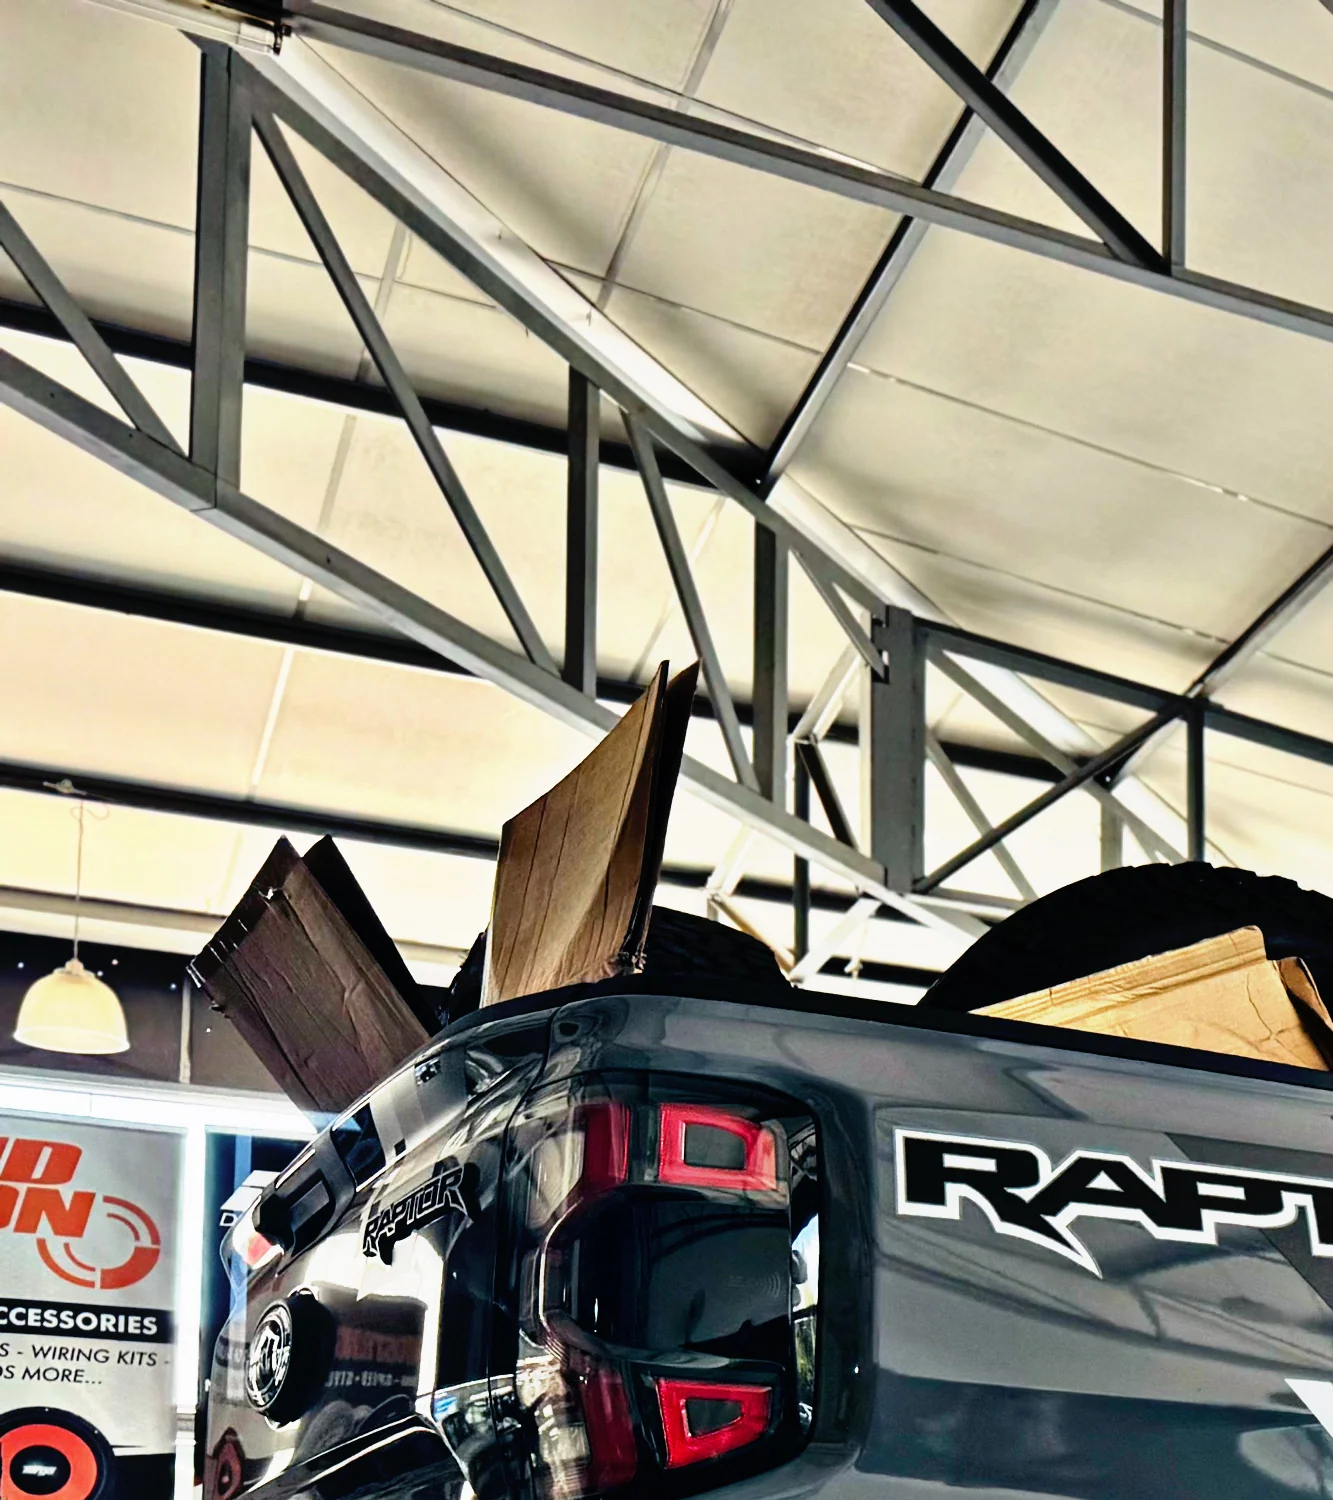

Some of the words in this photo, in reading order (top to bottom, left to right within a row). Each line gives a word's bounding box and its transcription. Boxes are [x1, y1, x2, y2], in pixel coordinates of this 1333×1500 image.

[0, 1137, 83, 1185] D
[362, 1165, 469, 1257] RAPTOR
[0, 1364, 15, 1379] S
[31, 1344, 110, 1364] WIRING
[117, 1349, 157, 1367] KITS
